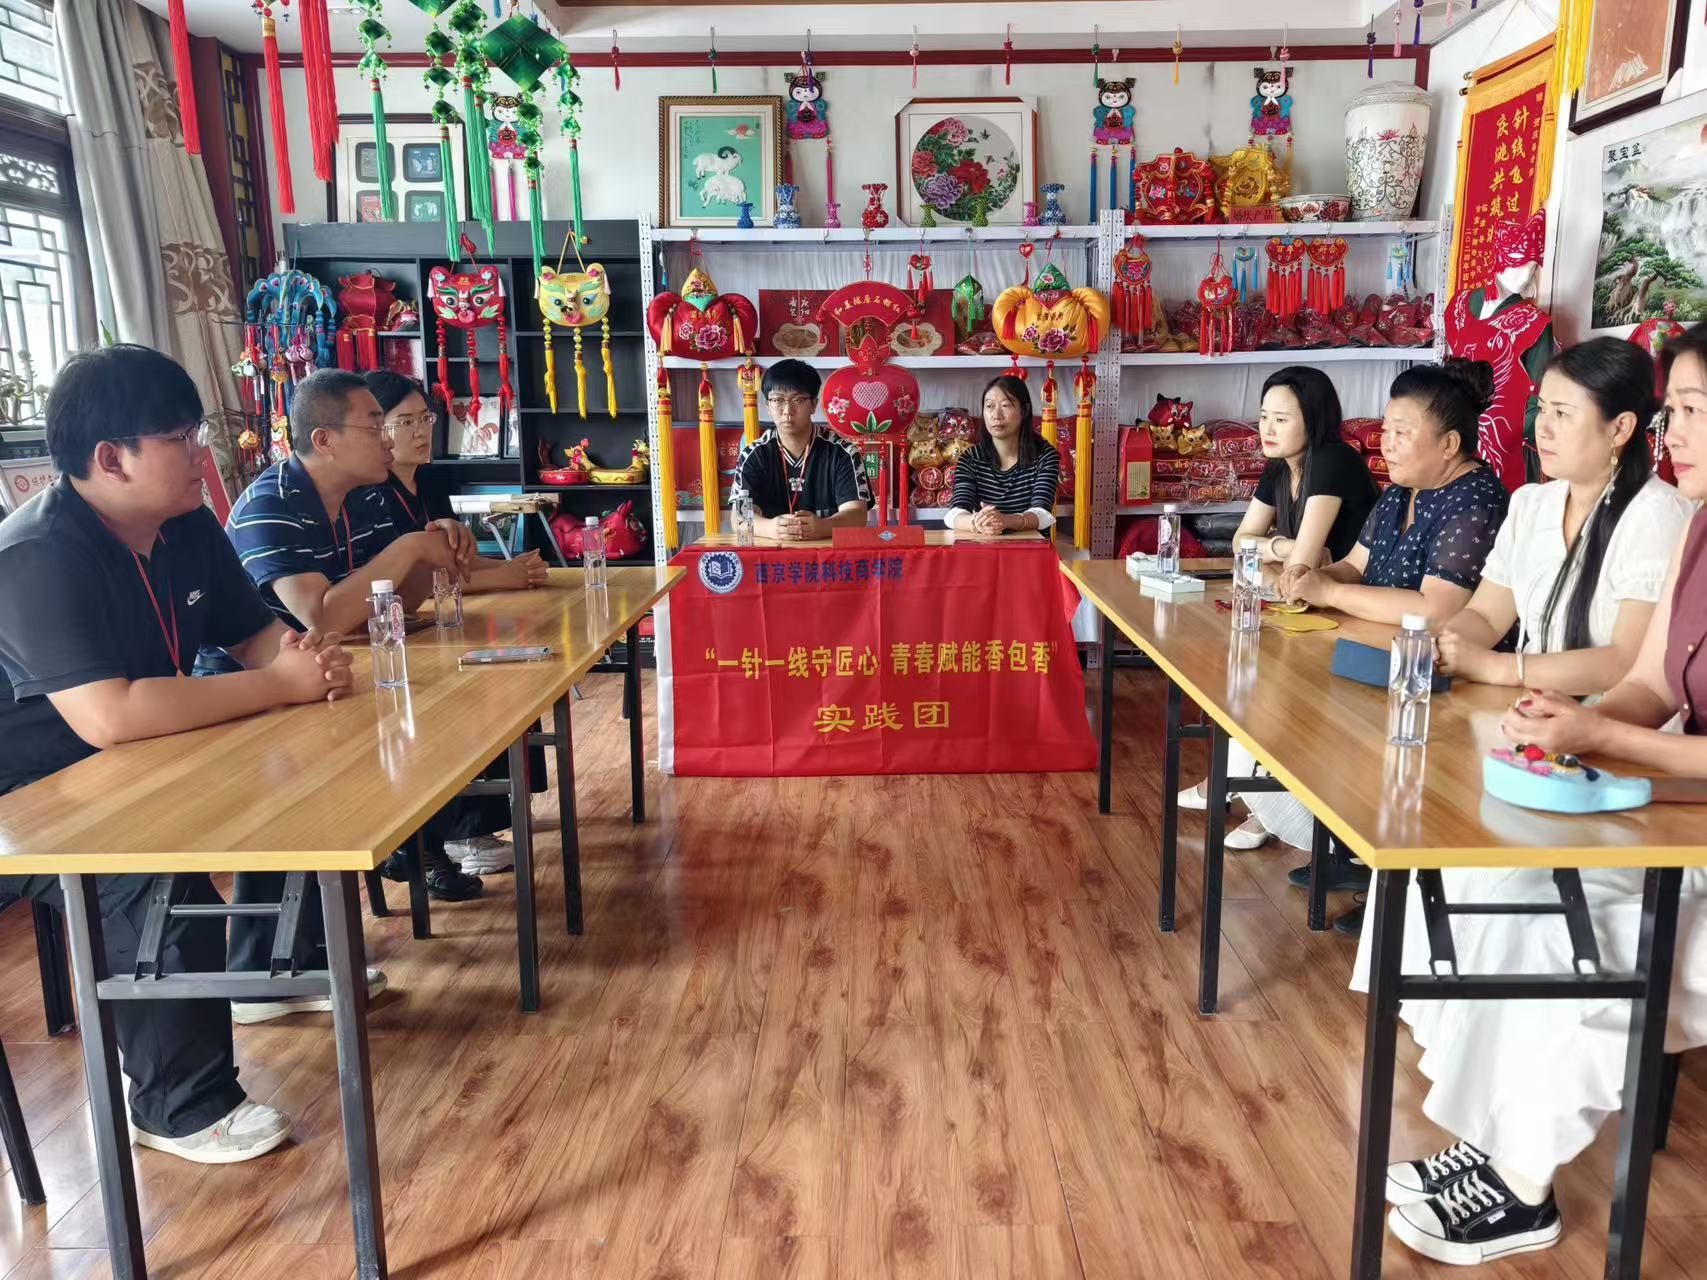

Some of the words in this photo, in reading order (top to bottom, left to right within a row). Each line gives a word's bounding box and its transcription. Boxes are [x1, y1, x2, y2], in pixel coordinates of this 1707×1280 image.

[1504, 105, 1530, 221] 针线飞过
[755, 556, 904, 585] 西京学院科技商学院
[705, 646, 880, 680] “一针一线守匠心
[813, 701, 950, 733] 实践团
